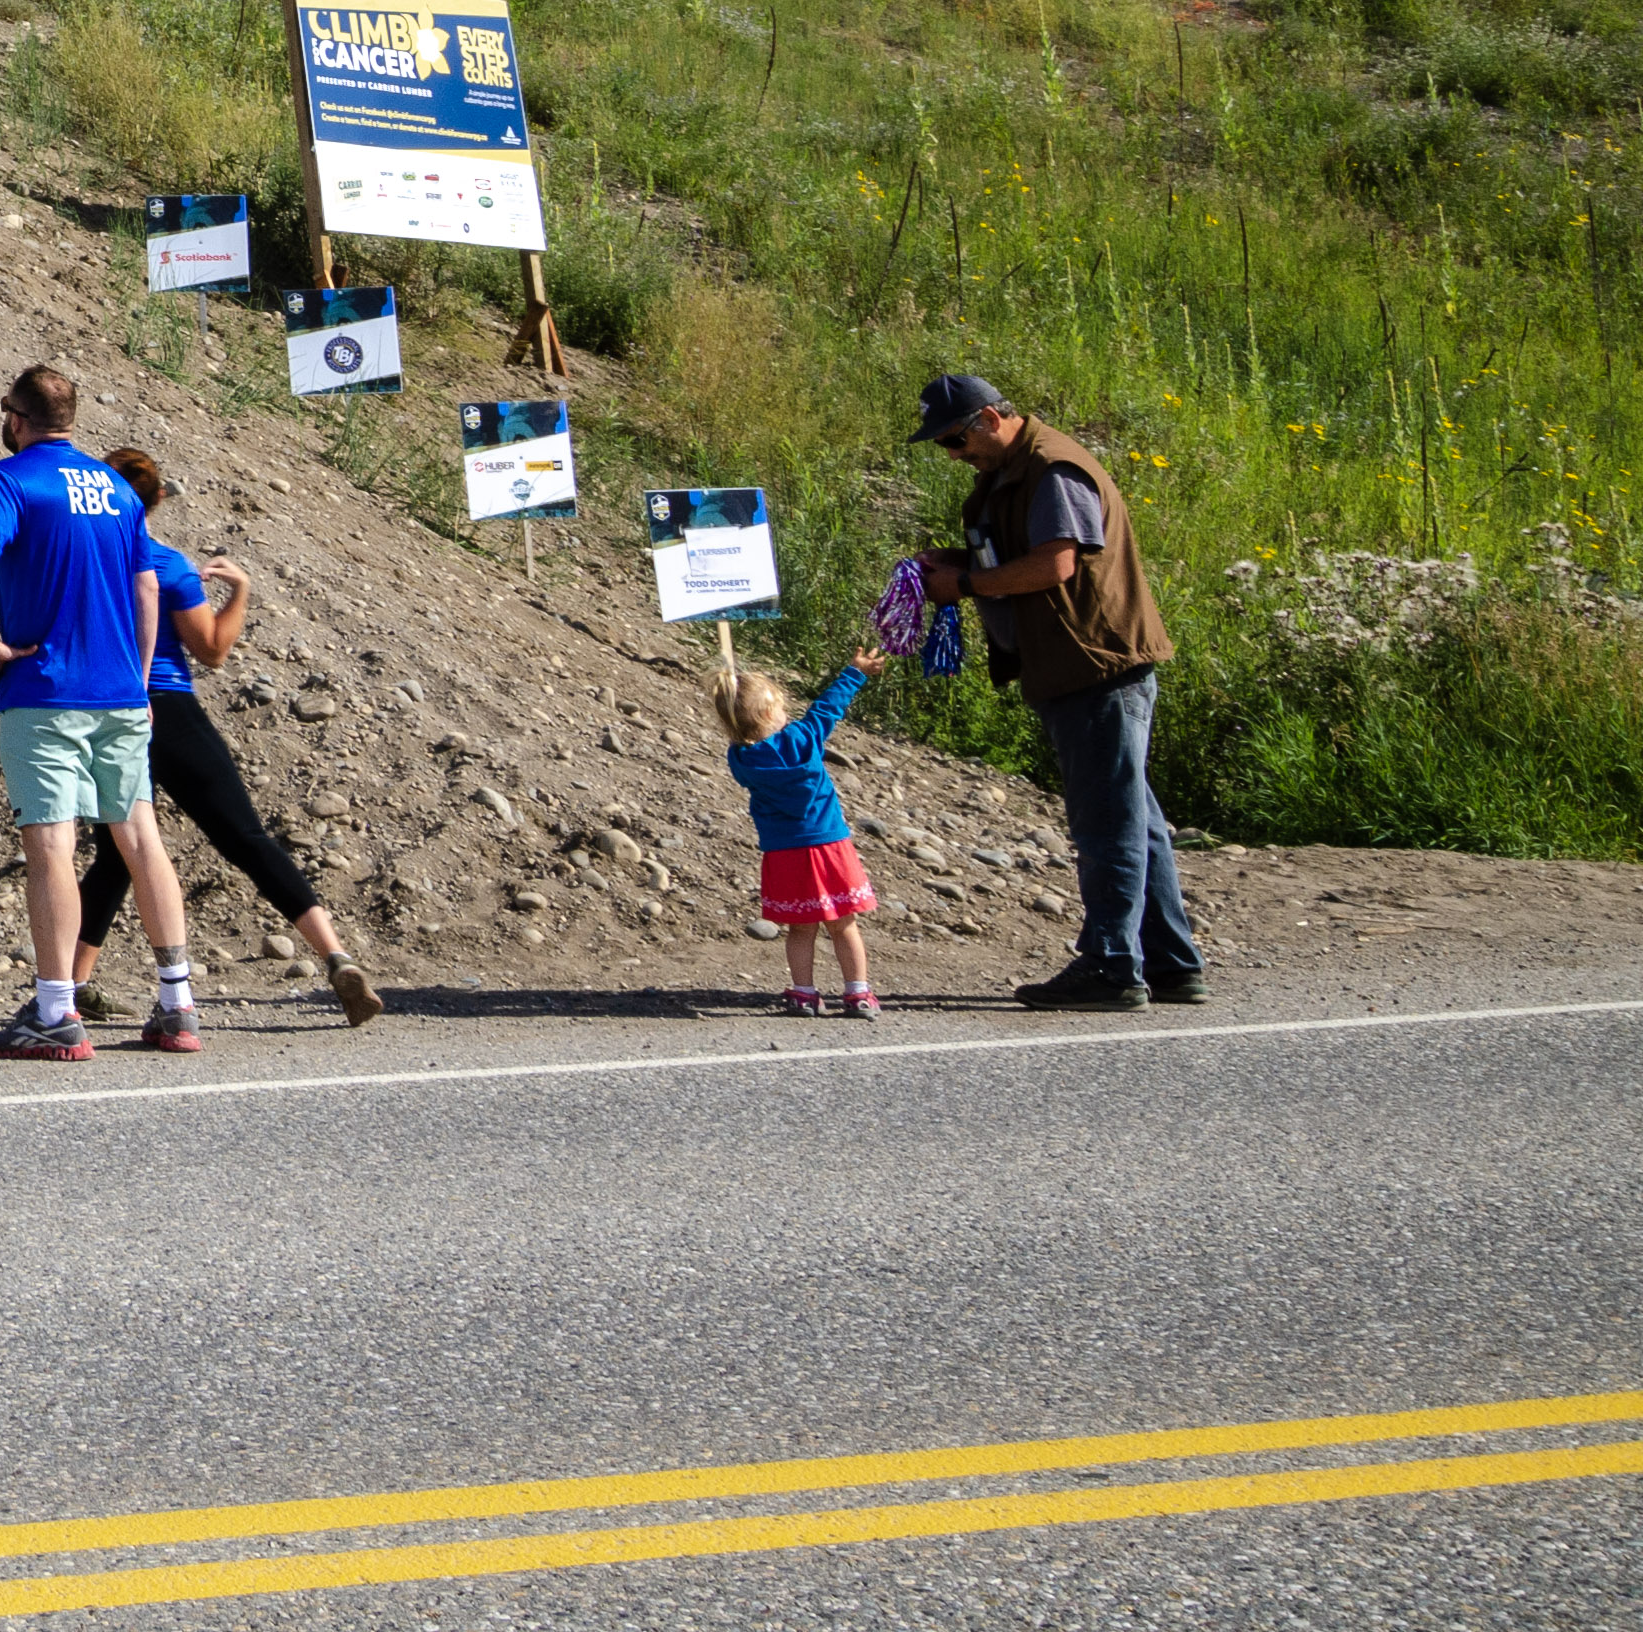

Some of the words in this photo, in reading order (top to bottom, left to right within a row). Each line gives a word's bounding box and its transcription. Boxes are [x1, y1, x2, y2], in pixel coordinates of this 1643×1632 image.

[308, 10, 412, 51] CLIMB
[457, 25, 505, 49] EVERY
[319, 40, 417, 79] CANCER
[461, 45, 509, 70] STEP
[316, 76, 356, 88] PRESENTED
[368, 82, 400, 93] CARRIER
[402, 86, 433, 98] LUMBER
[463, 67, 513, 88] COUNTS
[175, 253, 232, 261] Scotiabank
[334, 346, 355, 366] TBJ
[485, 462, 515, 470] HUBER
[59, 468, 114, 488] TEAM
[67, 486, 120, 515] RBC
[685, 580, 708, 588] TODD
[710, 579, 750, 587] DOHERTY
